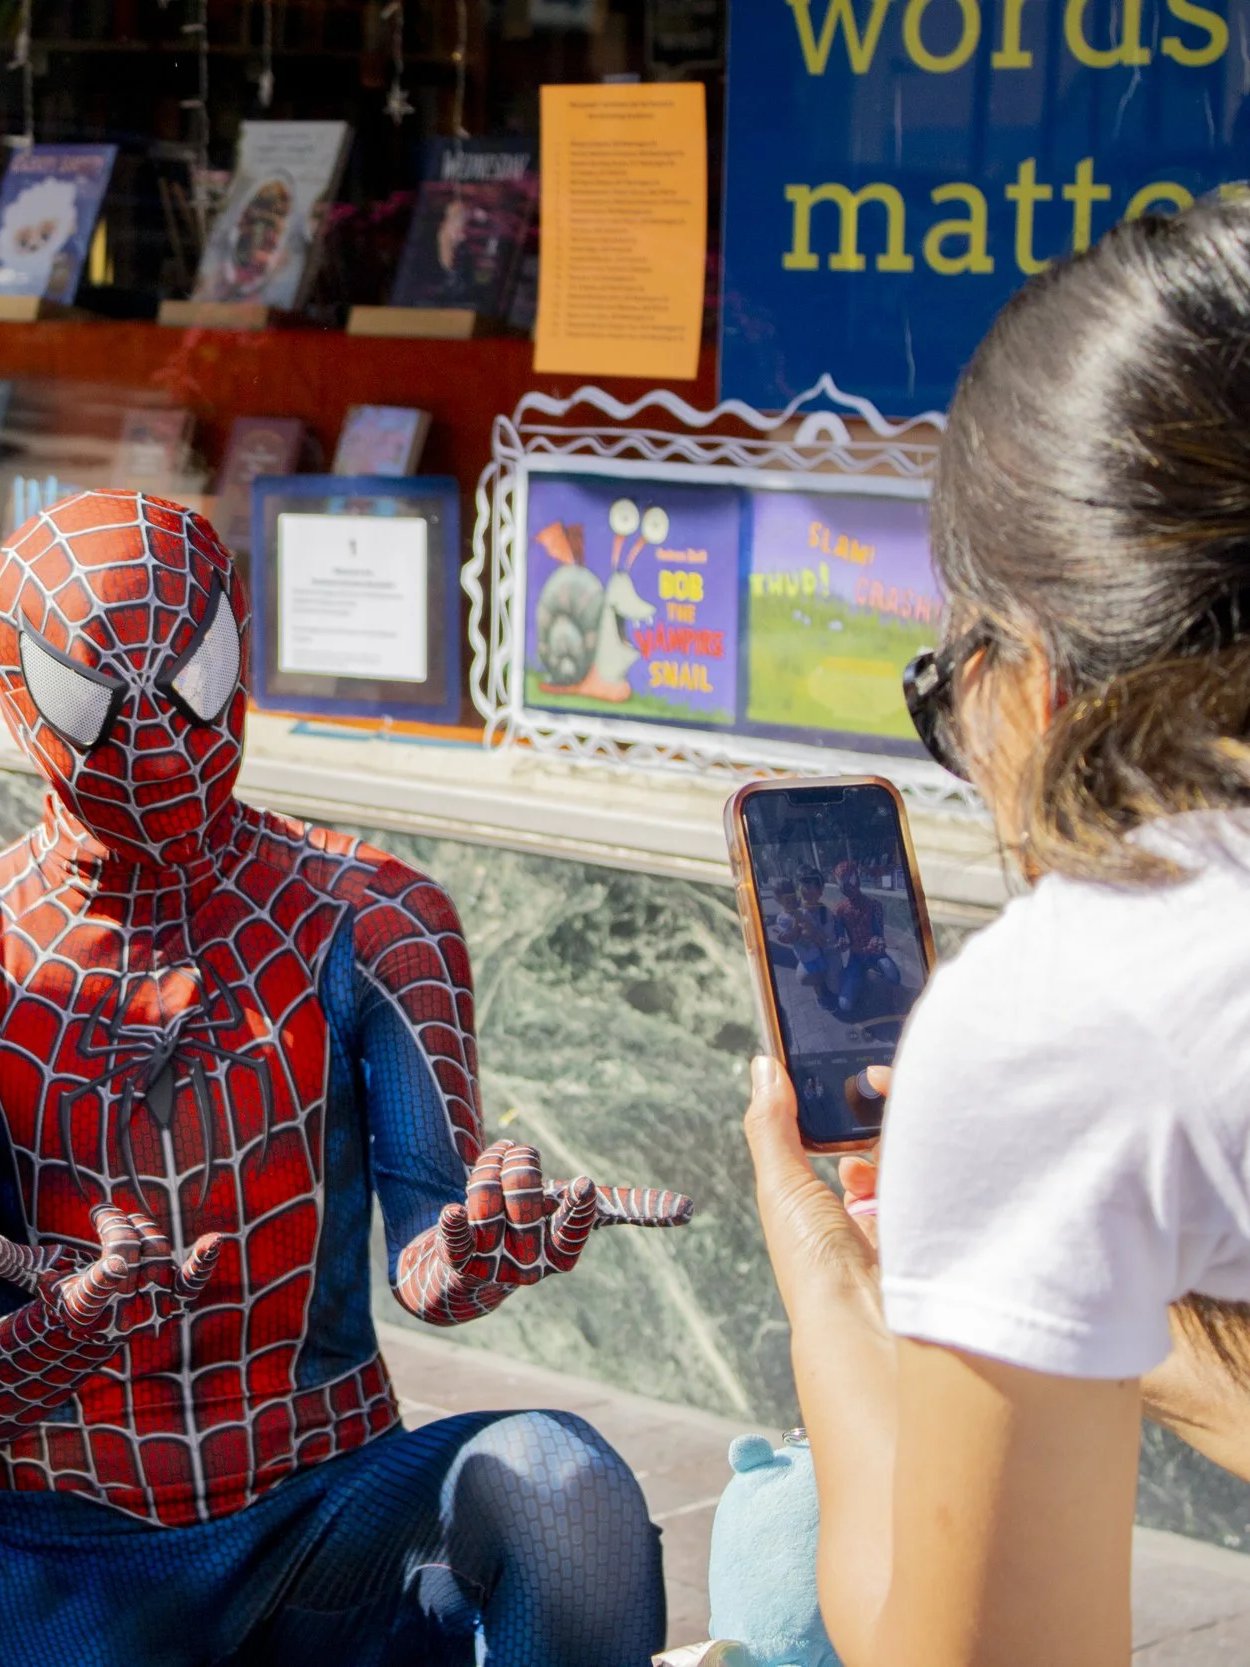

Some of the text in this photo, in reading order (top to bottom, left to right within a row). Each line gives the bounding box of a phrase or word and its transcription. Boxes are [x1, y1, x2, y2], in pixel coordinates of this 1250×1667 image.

[786, 0, 1230, 75] words
[658, 569, 704, 602] BOB
[666, 602, 696, 624] THE
[634, 620, 725, 660] VAMPIRE
[649, 660, 713, 693] SNAIL
